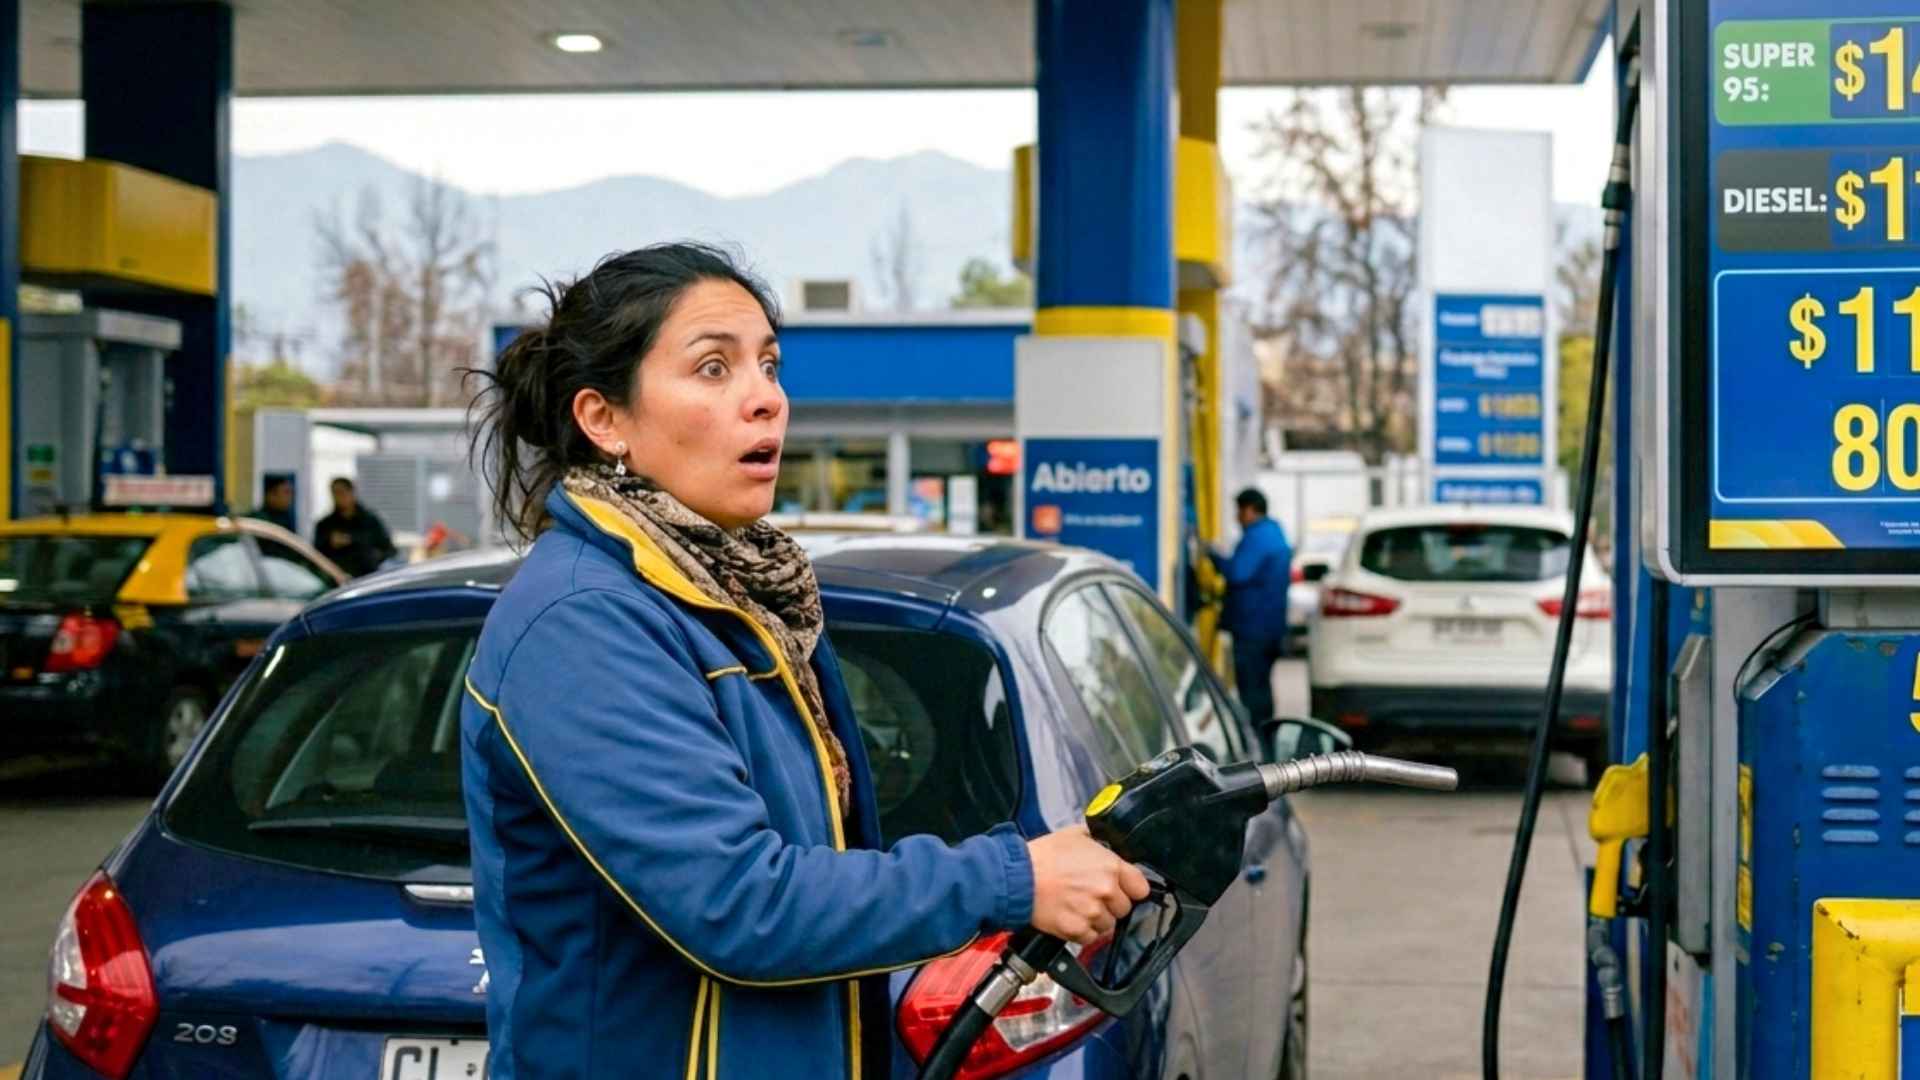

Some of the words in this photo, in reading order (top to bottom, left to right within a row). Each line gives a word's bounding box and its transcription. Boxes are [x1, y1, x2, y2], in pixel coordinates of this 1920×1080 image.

[1723, 42, 1816, 69] SUPER
[1723, 76, 1770, 103] 95:
[1834, 26, 1920, 111] $1
[1723, 187, 1828, 214] DIESEL:
[1835, 156, 1920, 242] $1
[1030, 460, 1152, 494] Abierto
[1831, 402, 1920, 492] 80
